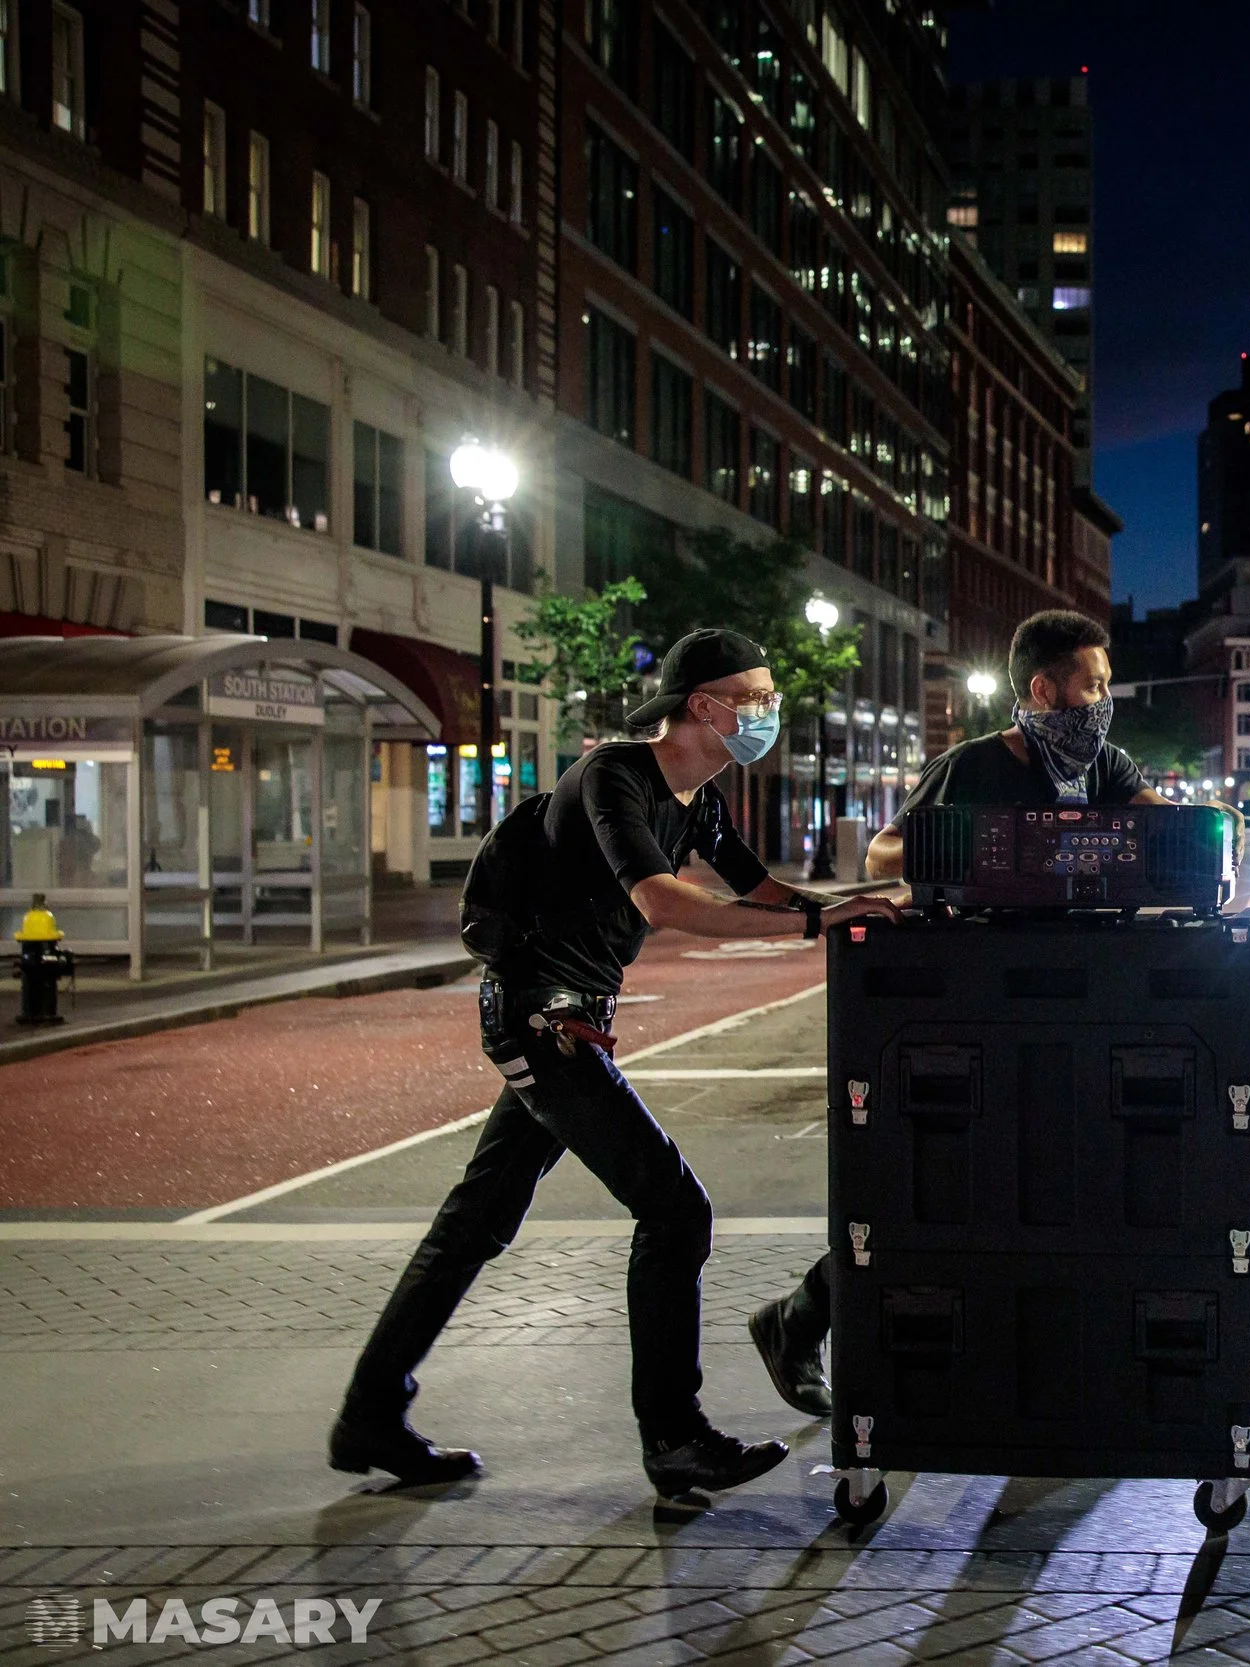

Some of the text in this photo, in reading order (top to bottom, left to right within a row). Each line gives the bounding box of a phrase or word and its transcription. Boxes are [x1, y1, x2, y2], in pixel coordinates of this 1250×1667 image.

[223, 675, 316, 704] SOUTH STATION
[255, 704, 286, 718] DUDLEY
